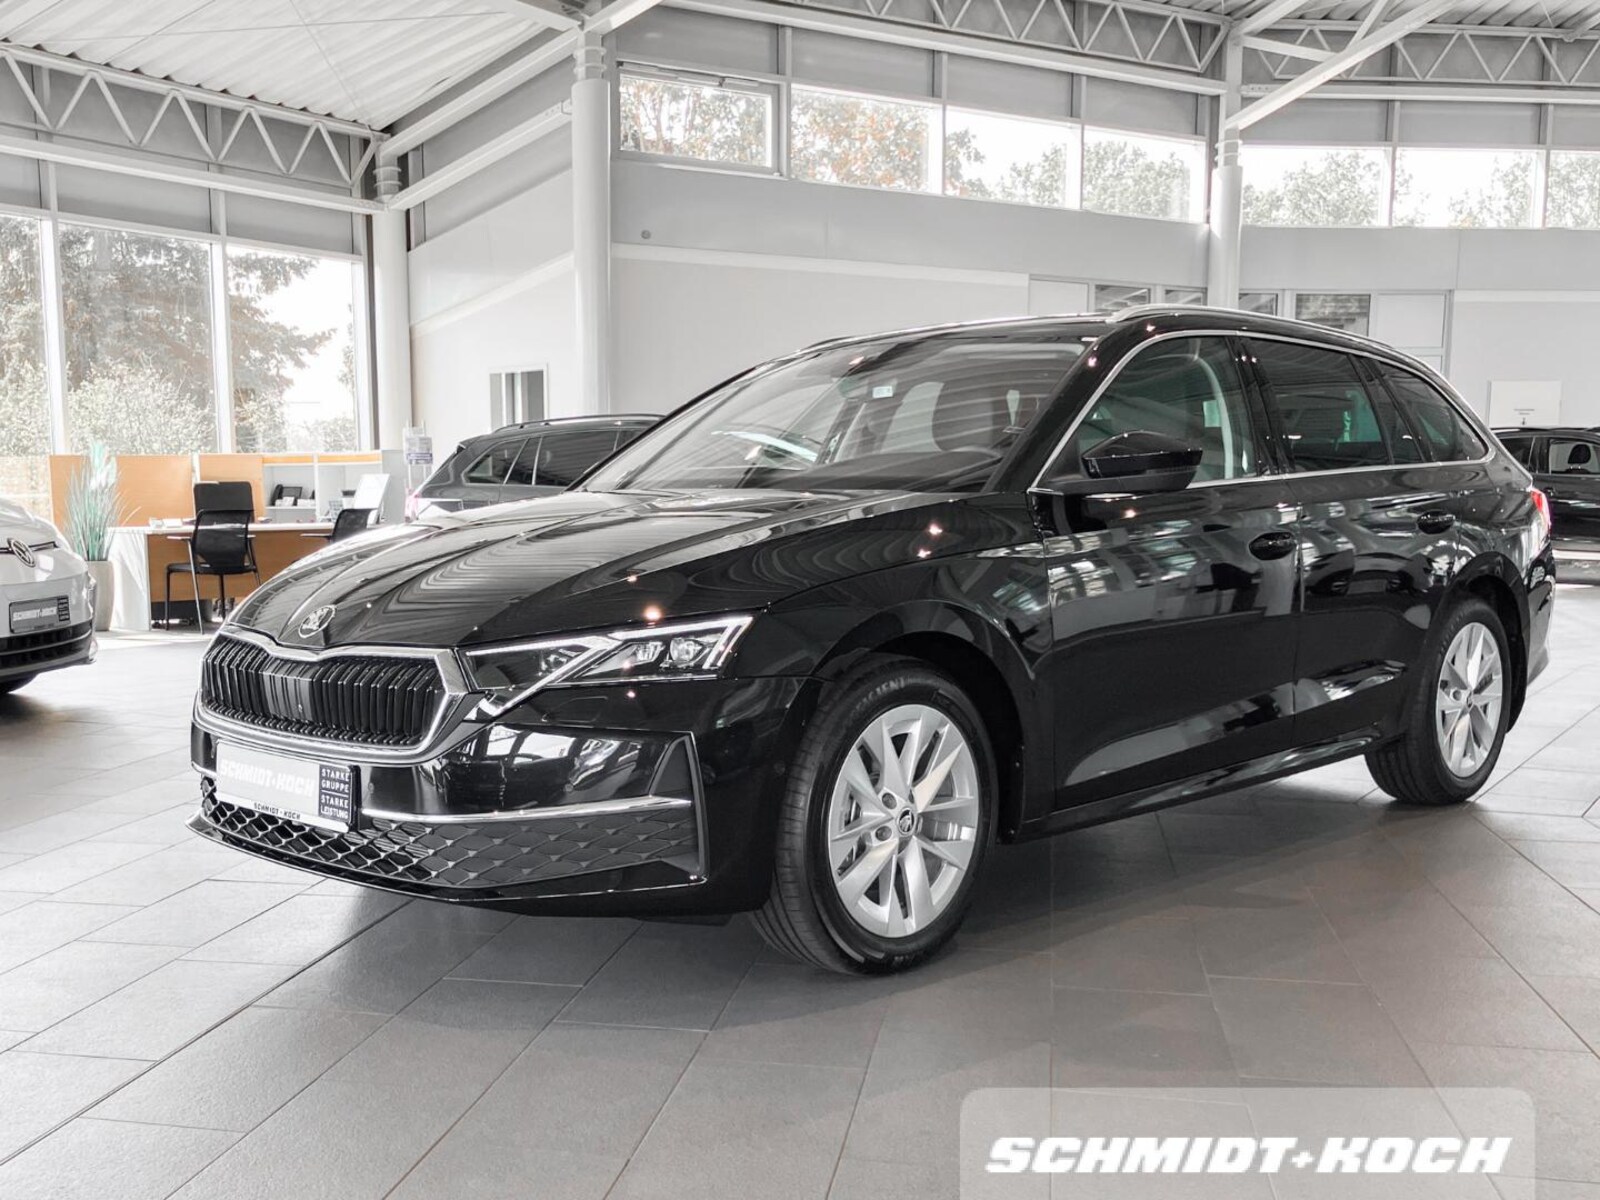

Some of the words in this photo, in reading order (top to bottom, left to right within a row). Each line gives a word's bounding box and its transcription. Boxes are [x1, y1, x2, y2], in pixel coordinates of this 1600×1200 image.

[321, 768, 350, 782] STARKE
[321, 779, 350, 793] GRUPPE
[321, 794, 349, 809] STARKE
[320, 804, 349, 820] LEISTUNG
